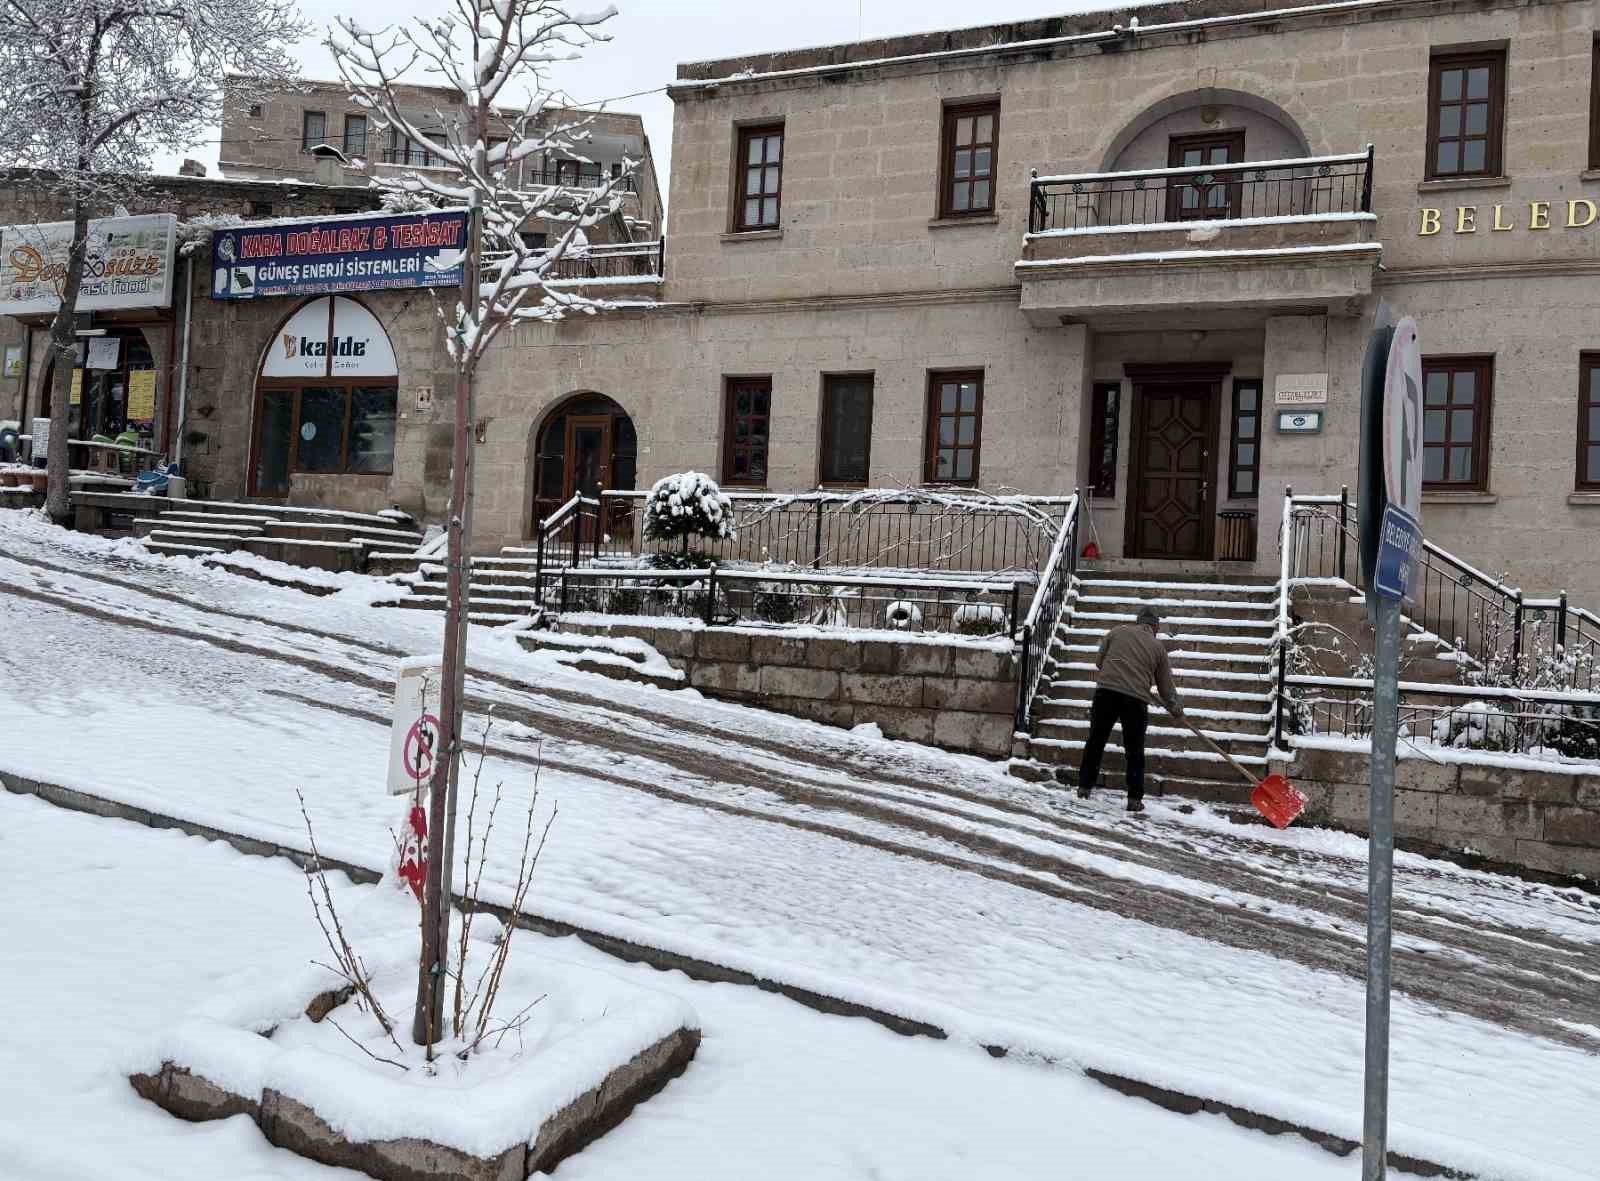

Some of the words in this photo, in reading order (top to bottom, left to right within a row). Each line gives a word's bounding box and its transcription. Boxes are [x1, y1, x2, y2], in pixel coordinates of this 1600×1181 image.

[1417, 199, 1597, 236] BELED
[241, 233, 283, 259] KARA
[286, 226, 370, 256] DOĞALGAZ
[391, 219, 462, 249] TESİSAT
[258, 261, 300, 284] GÜNEŞ
[302, 257, 344, 279] ENERJİ
[346, 252, 420, 277] SİSTEMLERİ
[112, 277, 151, 295] food
[300, 336, 366, 357] kalde
